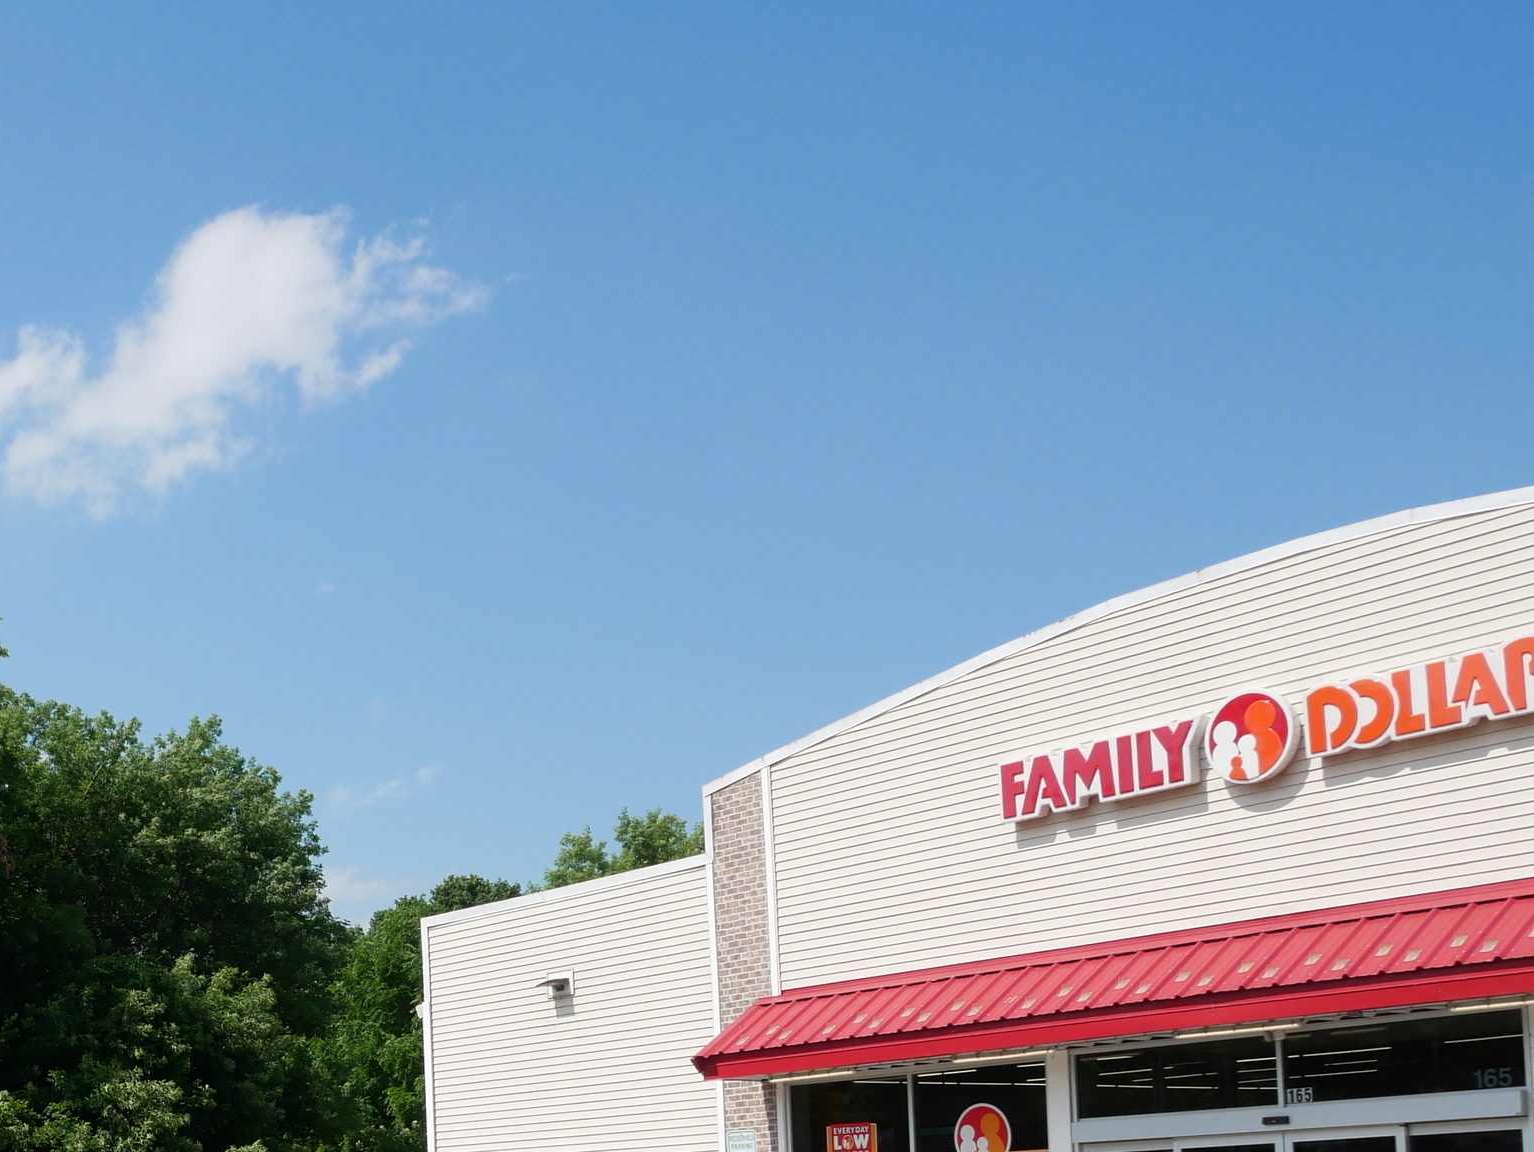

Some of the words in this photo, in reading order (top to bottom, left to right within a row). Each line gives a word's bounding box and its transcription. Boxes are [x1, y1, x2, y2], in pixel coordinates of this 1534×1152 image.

[999, 718, 1195, 821] FAMILY
[1472, 1067, 1513, 1089] 165
[1288, 1087, 1312, 1104] 165
[833, 1126, 869, 1135] EVERYDAY
[833, 1134, 870, 1151] LOW
